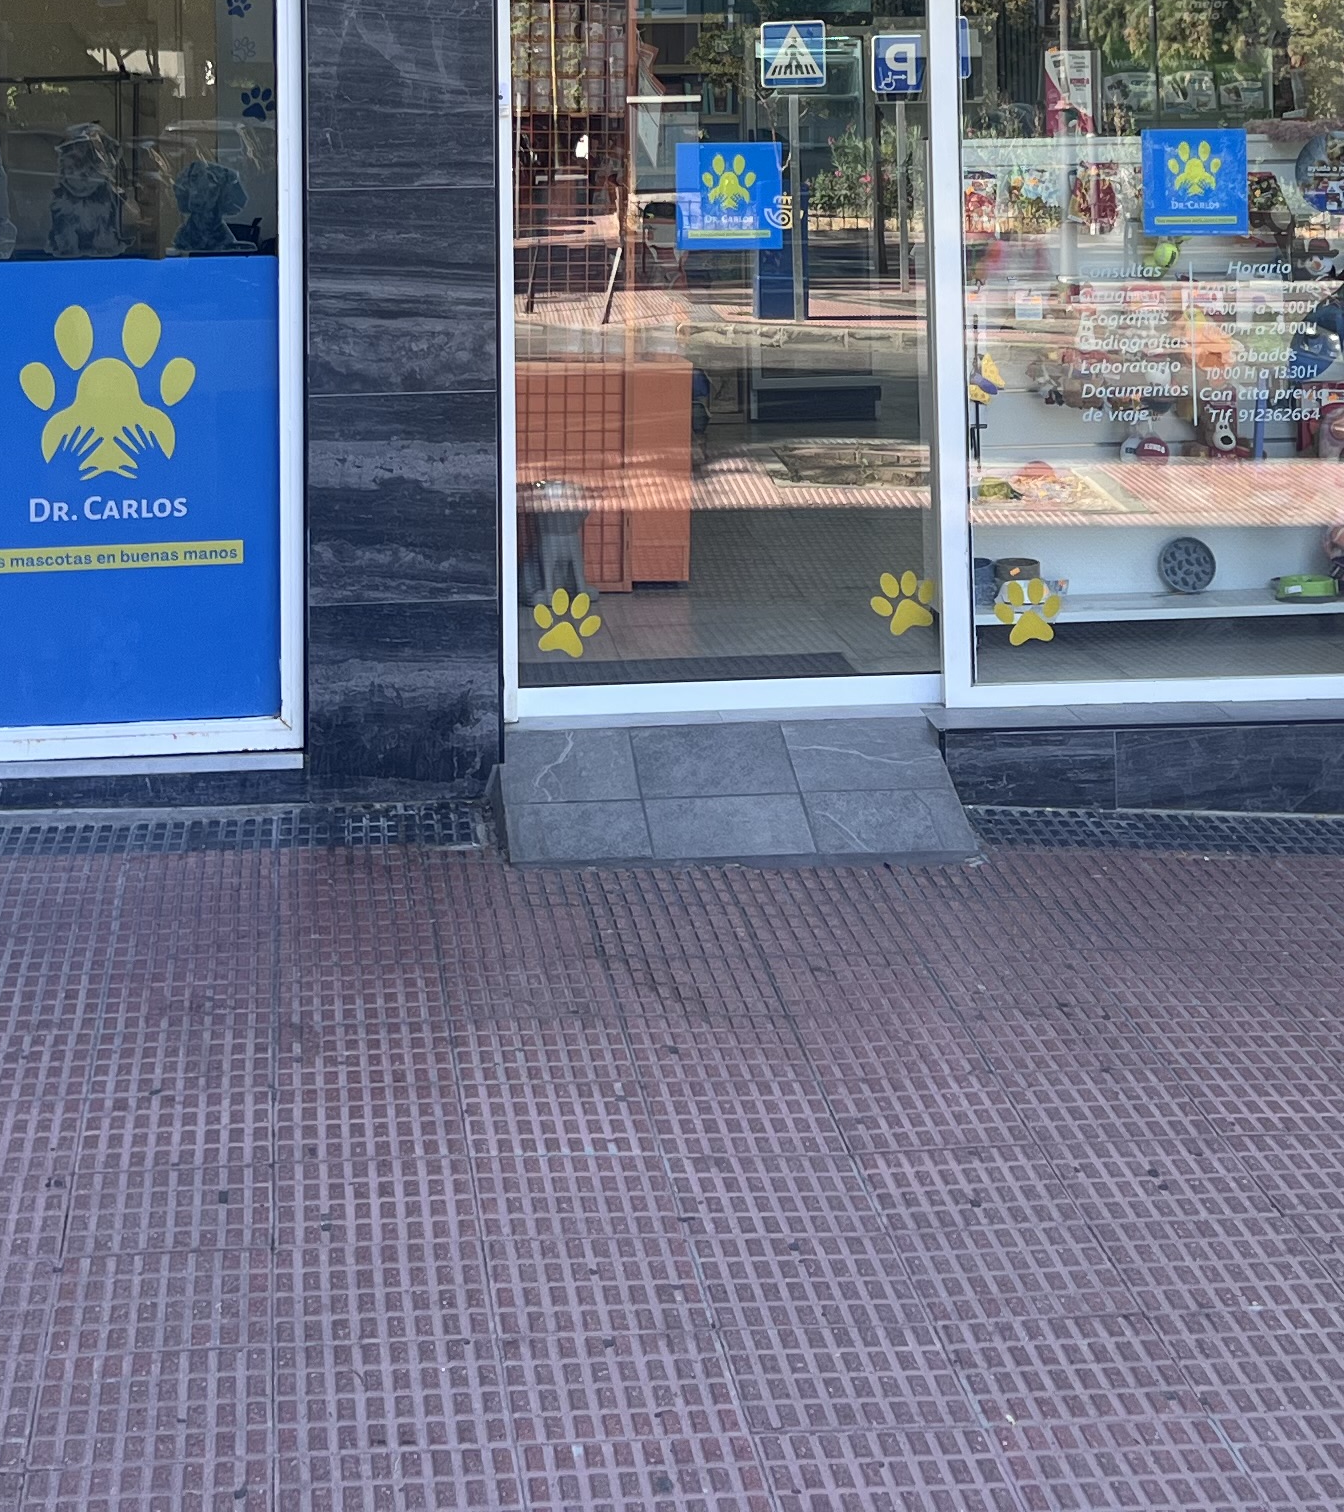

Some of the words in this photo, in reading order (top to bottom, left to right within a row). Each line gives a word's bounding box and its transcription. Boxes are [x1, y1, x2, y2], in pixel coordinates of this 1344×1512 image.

[1079, 264, 1162, 278] Consultas
[1227, 260, 1292, 275] Horario
[1081, 357, 1181, 374] Laboratorio
[1206, 367, 1240, 380] 10:00
[1245, 367, 1255, 380] H
[1259, 370, 1269, 379] a
[1274, 366, 1305, 379] 13:30
[1307, 365, 1317, 378] H
[1082, 383, 1189, 398] Documentos
[1200, 387, 1232, 401] Con
[1238, 387, 1269, 401] cita
[1273, 385, 1329, 406] previa
[1082, 407, 1103, 422] de
[1109, 407, 1149, 425] viaje
[1209, 409, 1233, 423] Tlf.
[1239, 407, 1320, 422] 912362664
[9, 551, 92, 568] mascotas
[96, 552, 116, 565] en
[120, 547, 179, 563] buenas
[183, 546, 238, 562] manos
